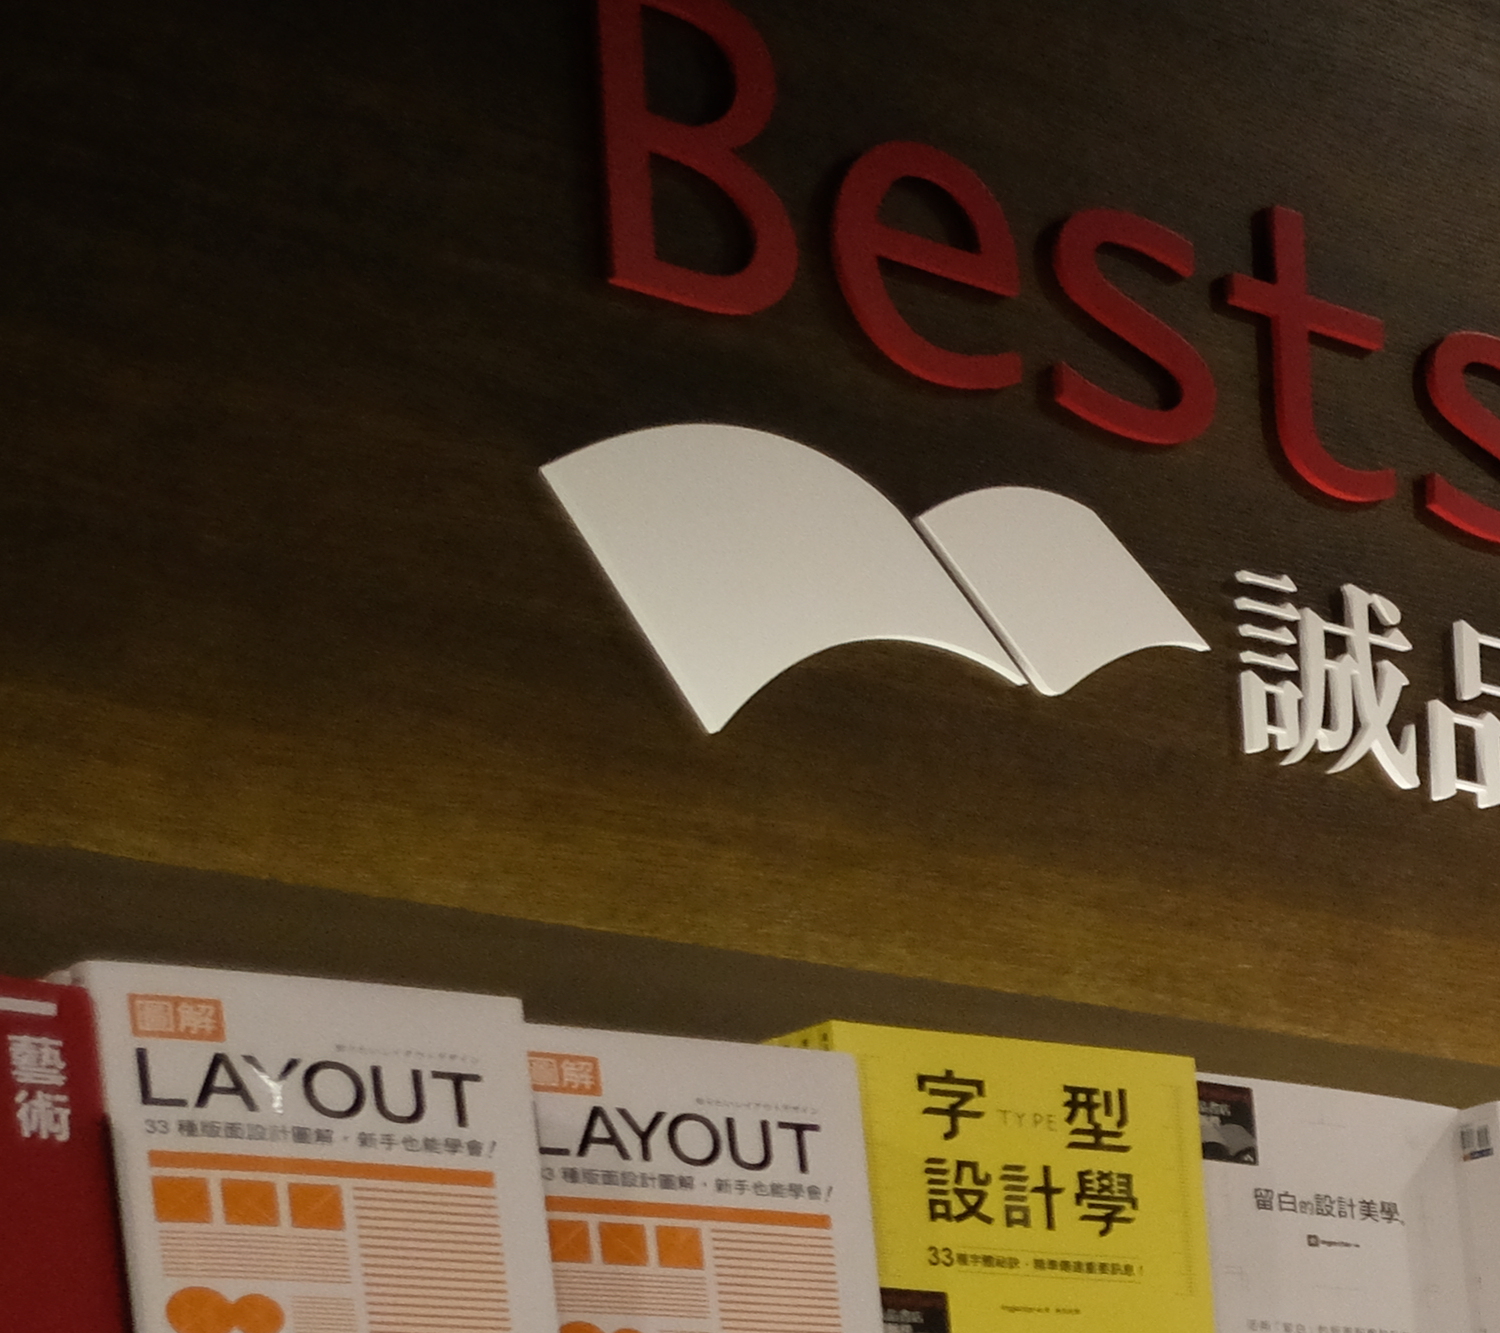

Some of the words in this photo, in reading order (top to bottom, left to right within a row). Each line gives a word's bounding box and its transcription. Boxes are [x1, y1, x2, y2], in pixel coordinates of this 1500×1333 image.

[131, 997, 222, 1039] 圖解
[6, 1032, 72, 1144] 藝術
[134, 1046, 484, 1129] LAYOUT
[923, 1156, 1139, 1238] 設計學
